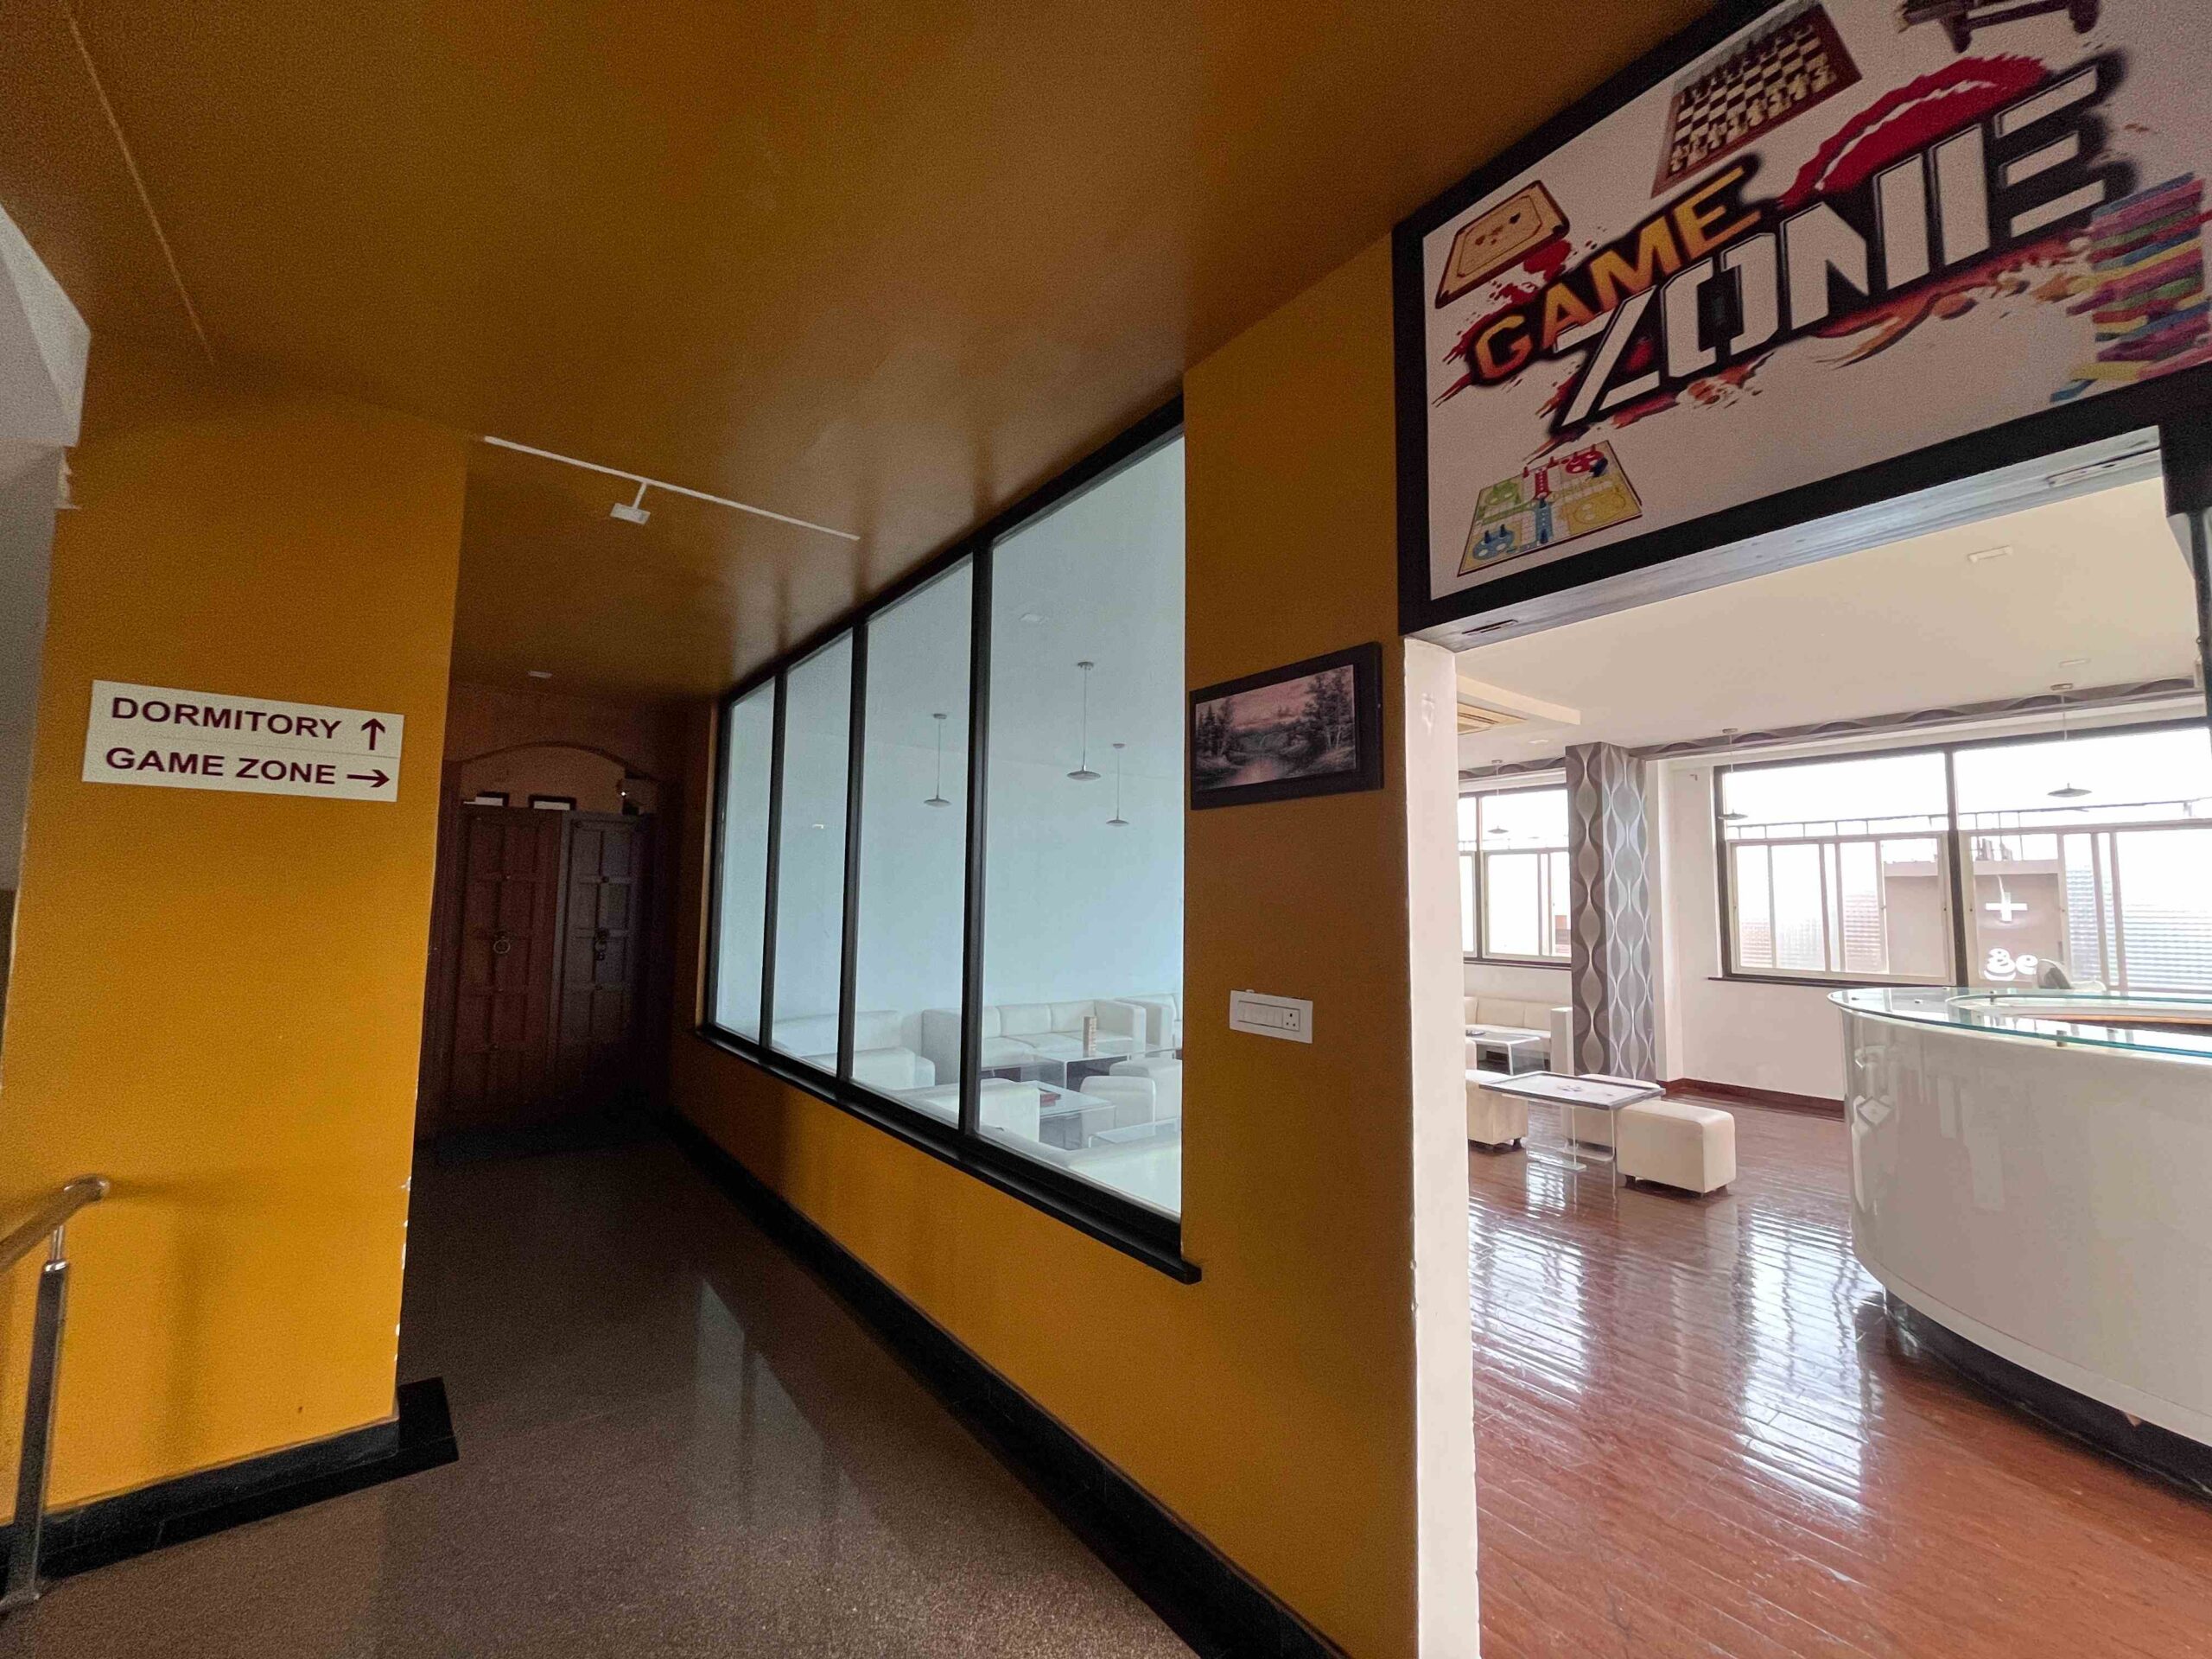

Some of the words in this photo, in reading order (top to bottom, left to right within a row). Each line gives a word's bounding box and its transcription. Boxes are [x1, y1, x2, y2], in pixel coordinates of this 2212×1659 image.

[1472, 165, 1761, 382] GAME
[1552, 67, 2107, 428] ZONE
[105, 747, 225, 777] GAME
[235, 757, 337, 785] ZONE
[111, 696, 342, 740] DORMITORY
